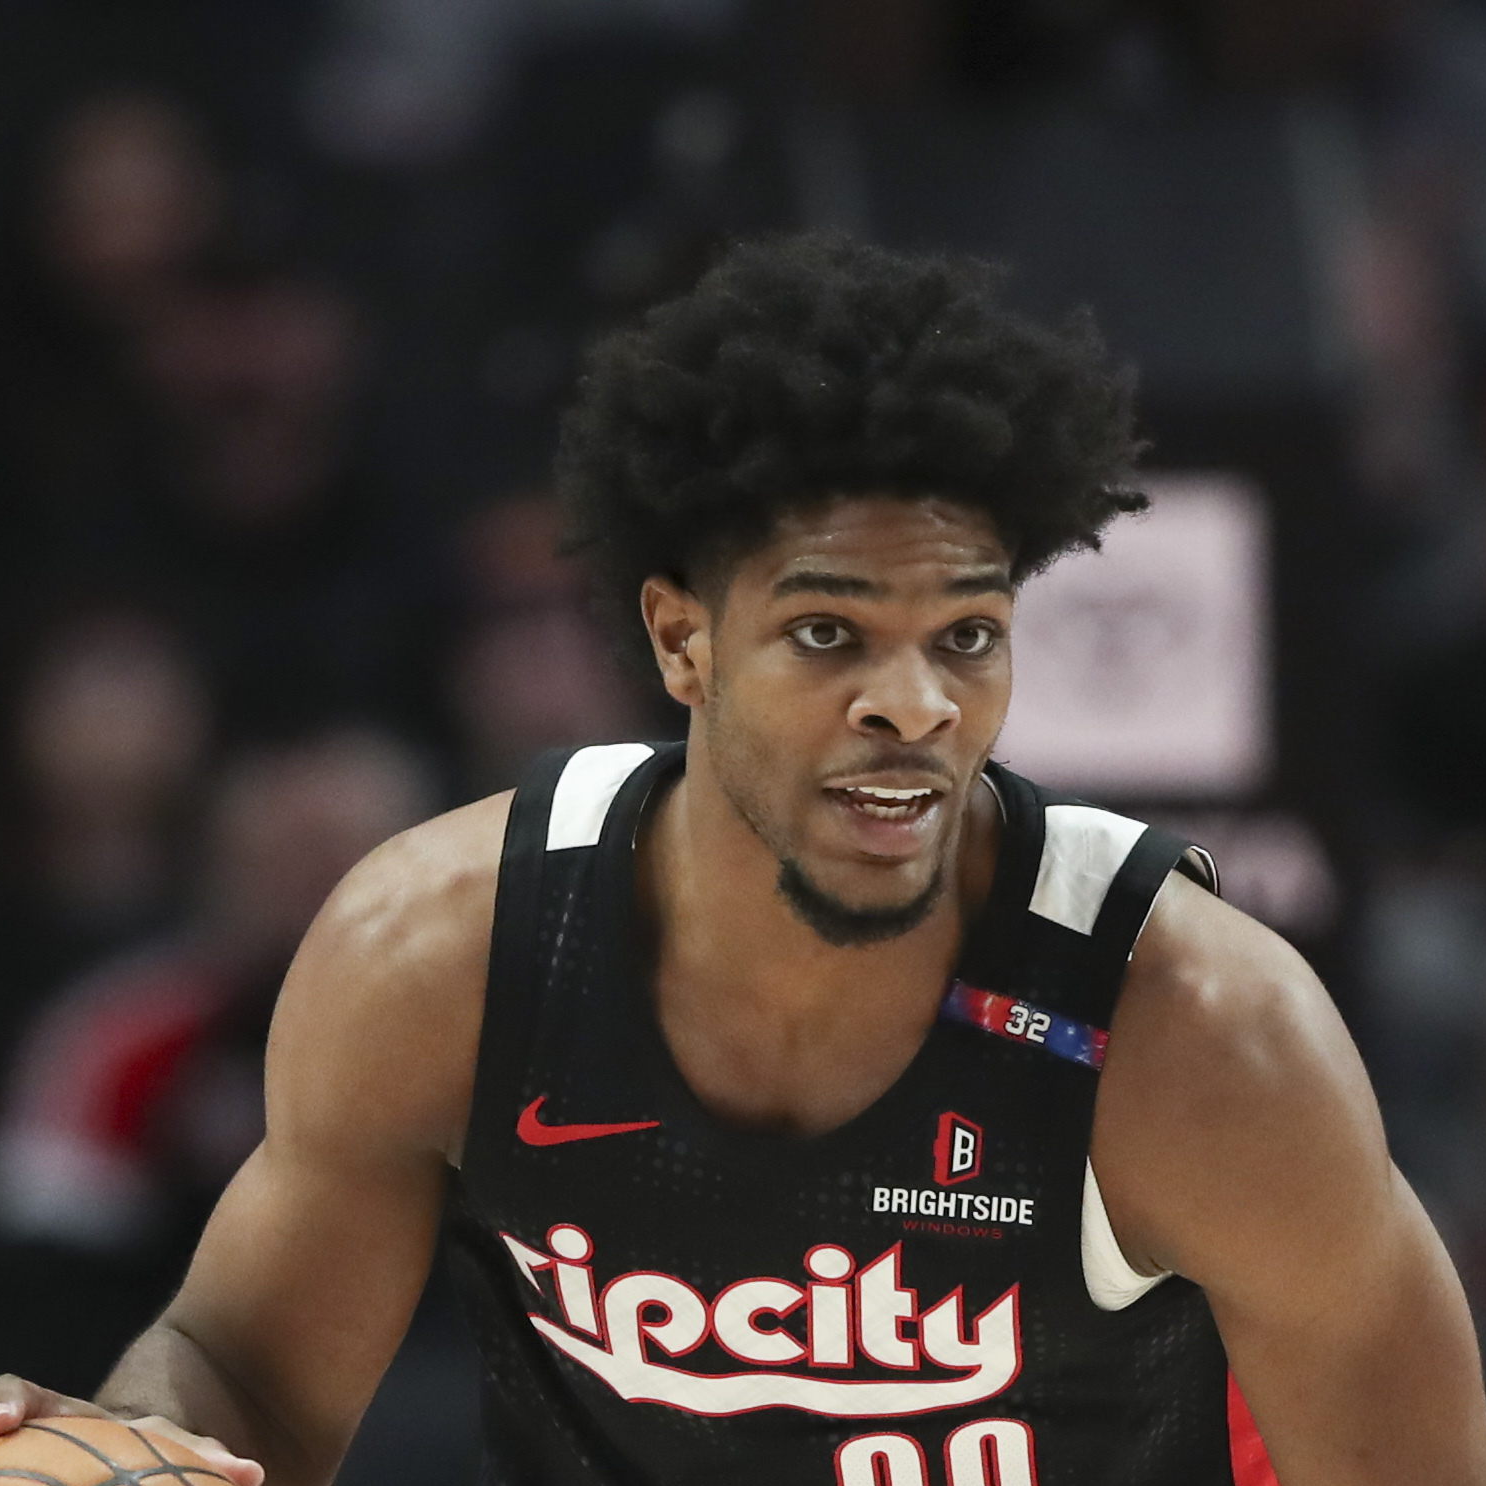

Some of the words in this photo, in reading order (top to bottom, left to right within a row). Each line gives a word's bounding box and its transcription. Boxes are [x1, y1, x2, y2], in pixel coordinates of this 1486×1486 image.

[1004, 1004, 1052, 1044] 32
[951, 1126, 976, 1173] B
[872, 1186, 1035, 1226] BRIGHTSIDE
[902, 1219, 1003, 1240] WINDOWS
